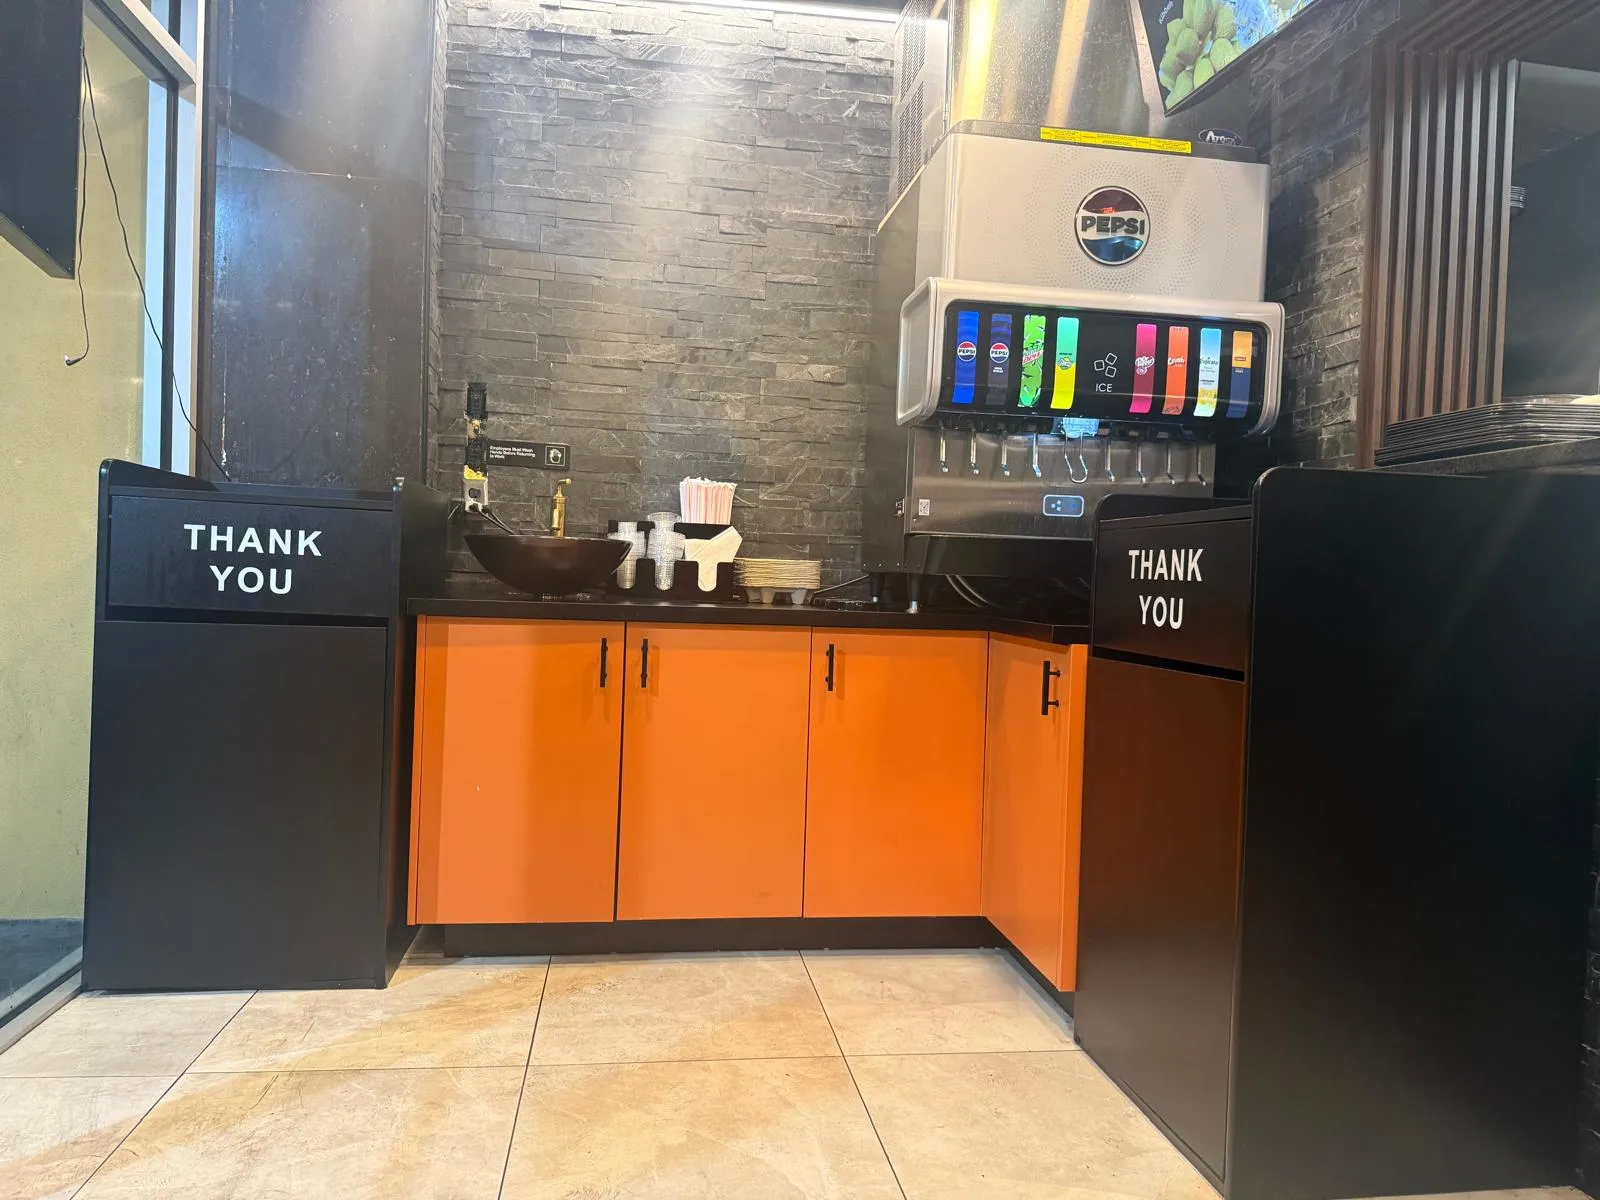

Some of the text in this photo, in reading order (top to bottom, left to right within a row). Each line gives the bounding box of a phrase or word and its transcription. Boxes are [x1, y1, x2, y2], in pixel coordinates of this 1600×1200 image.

[1081, 215, 1146, 235] PEPSI
[1168, 357, 1185, 365] Crush
[1095, 383, 1113, 393] ICE
[183, 523, 323, 557] THANK
[209, 565, 293, 595] YOU
[1128, 548, 1204, 582] THANK
[1138, 594, 1184, 630] YOU
